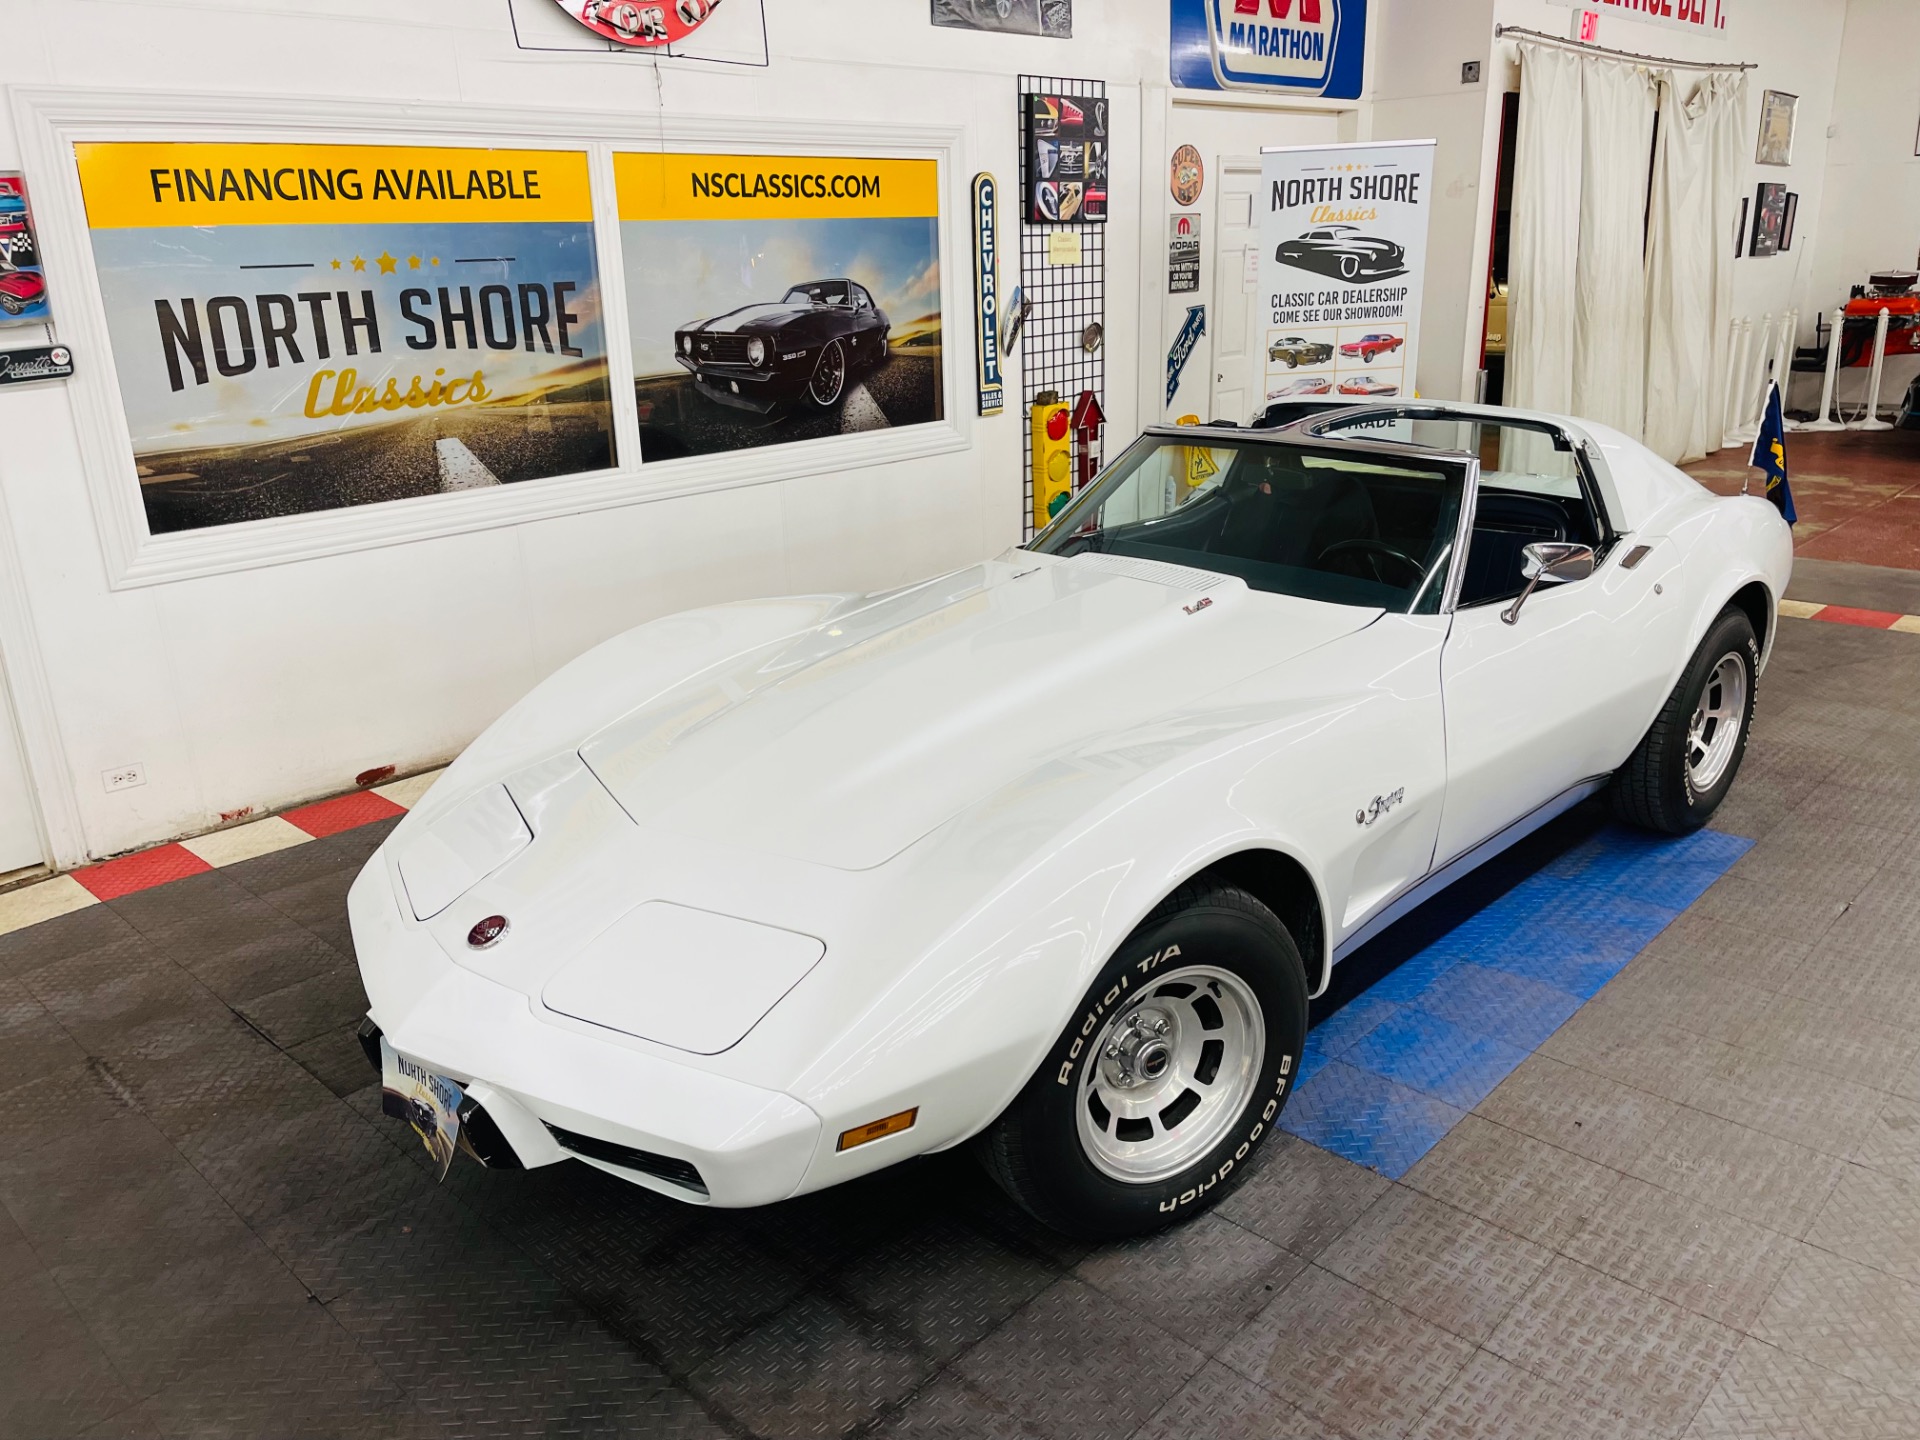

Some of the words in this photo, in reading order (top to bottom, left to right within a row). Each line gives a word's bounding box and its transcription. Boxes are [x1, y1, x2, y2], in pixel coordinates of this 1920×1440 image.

[1229, 21, 1325, 62] MARATHON
[1580, 11, 1599, 42] EXIT
[151, 168, 362, 203] FINANCING
[372, 168, 542, 200] AVAILABLE
[691, 172, 881, 199] NSCLASSICS.COM
[1177, 181, 1199, 203] BEE
[1271, 176, 1343, 212] NORTH
[1349, 172, 1421, 205] SHORE
[1309, 205, 1379, 224] Classics
[981, 185, 996, 380] CHEVROLET
[1271, 292, 1315, 309] CLASSIC
[1318, 290, 1339, 306] CAR
[1342, 287, 1408, 304] DEALERSHIP
[1273, 310, 1300, 324] COME
[1303, 309, 1320, 322] SEE
[1323, 308, 1342, 321] OUR
[1344, 305, 1403, 319] SHOWROOM!
[154, 289, 382, 392] NORTH
[399, 281, 584, 358] SHORE
[1172, 326, 1195, 370] Ford
[1191, 310, 1204, 331] PARTS
[0, 355, 53, 376] Corvette
[303, 366, 493, 420] Classics
[982, 392, 997, 401] SALES
[982, 399, 1003, 409] SERVICE
[1057, 975, 1129, 1087] Radial
[1136, 944, 1182, 974] T/A
